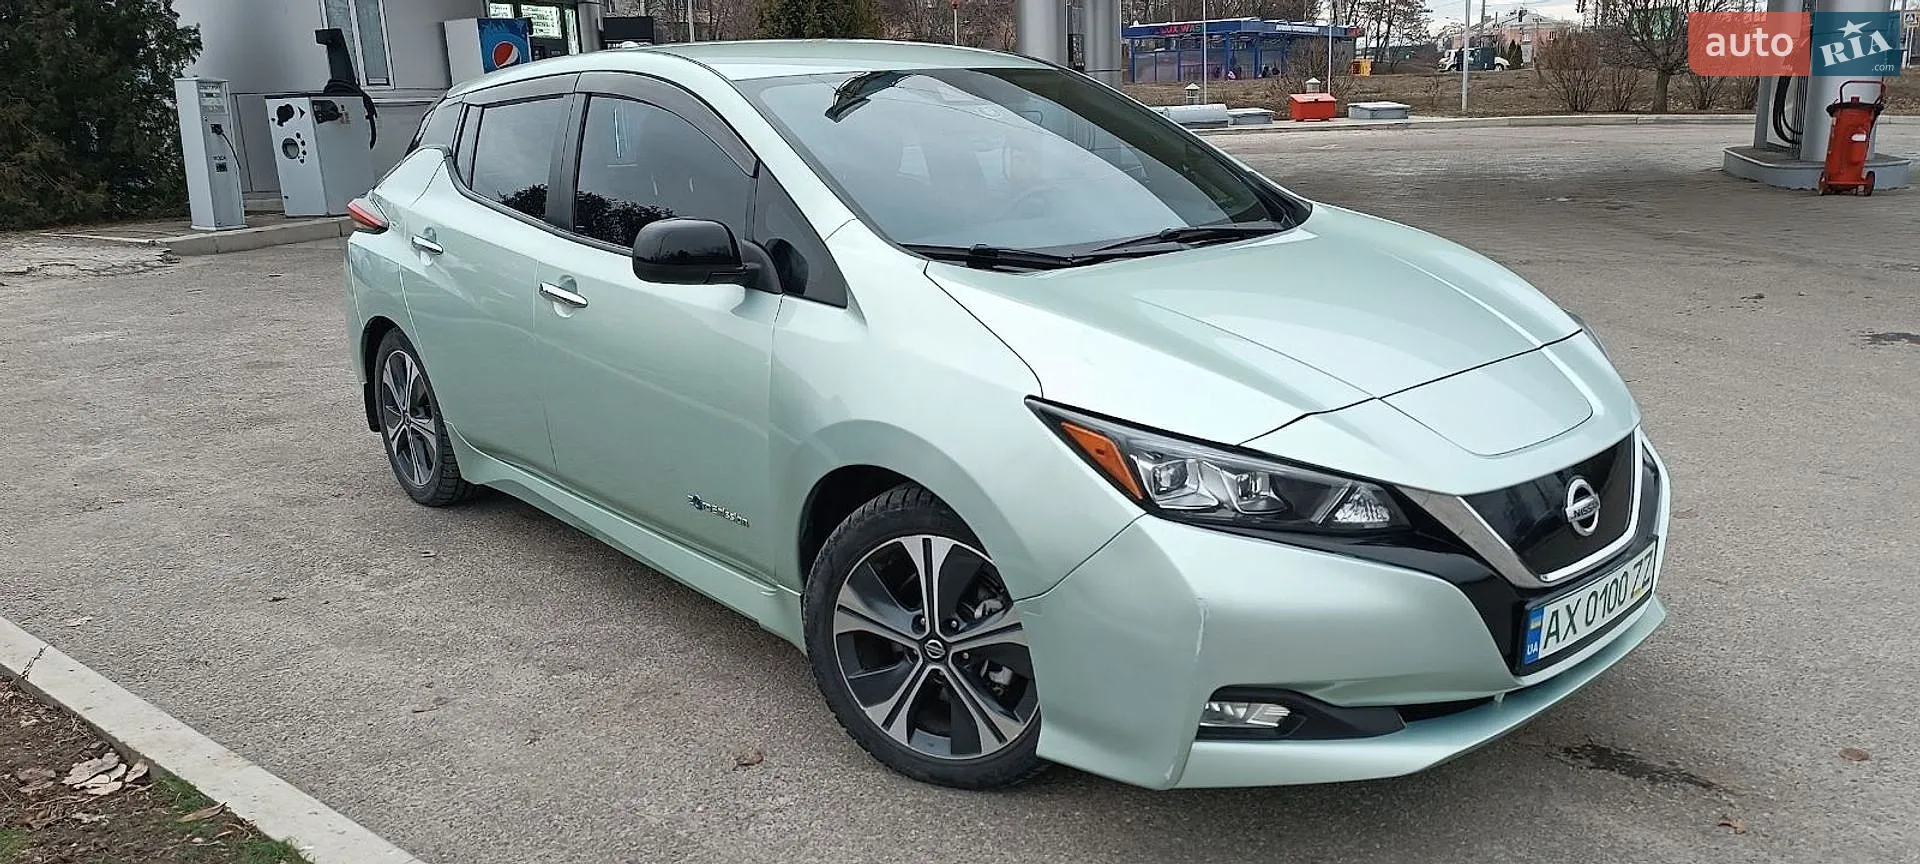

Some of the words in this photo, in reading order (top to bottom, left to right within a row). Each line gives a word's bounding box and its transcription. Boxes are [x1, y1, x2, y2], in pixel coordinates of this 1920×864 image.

[1543, 598, 1581, 650] AX
[1585, 571, 1628, 627] 0100
[1631, 550, 1653, 598] ZZ
[1526, 640, 1539, 656] UA
